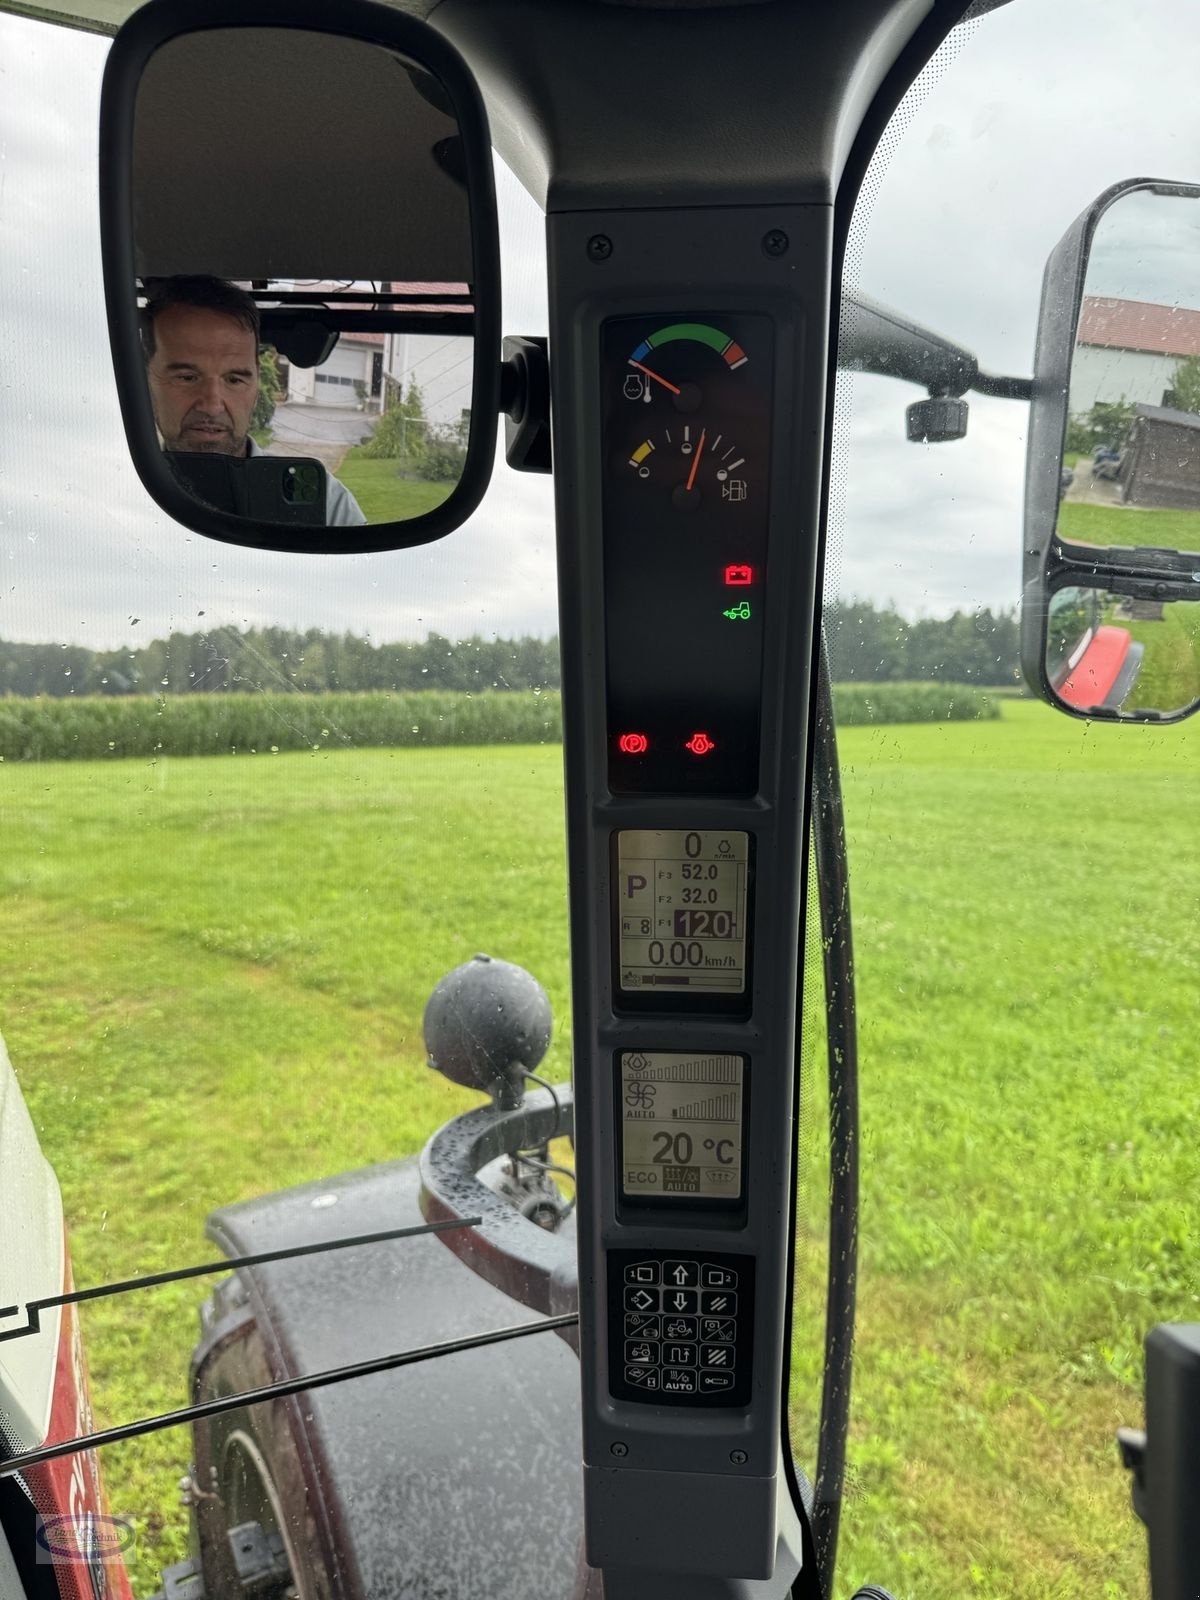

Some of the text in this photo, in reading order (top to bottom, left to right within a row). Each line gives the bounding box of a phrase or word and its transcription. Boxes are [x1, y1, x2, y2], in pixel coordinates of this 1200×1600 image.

[685, 832, 702, 858] 0
[658, 864, 718, 880] F3 52.0
[627, 875, 647, 899] P
[658, 888, 718, 904] F2 32.0
[640, 919, 650, 935] 8
[658, 919, 672, 927] F1
[648, 940, 736, 967] 0.00 km/h
[627, 1110, 656, 1119] AUTO
[652, 1131, 693, 1165] 20
[627, 1171, 658, 1184] ECO
[667, 1182, 696, 1192] AUTO
[665, 1382, 693, 1391] AUTO
